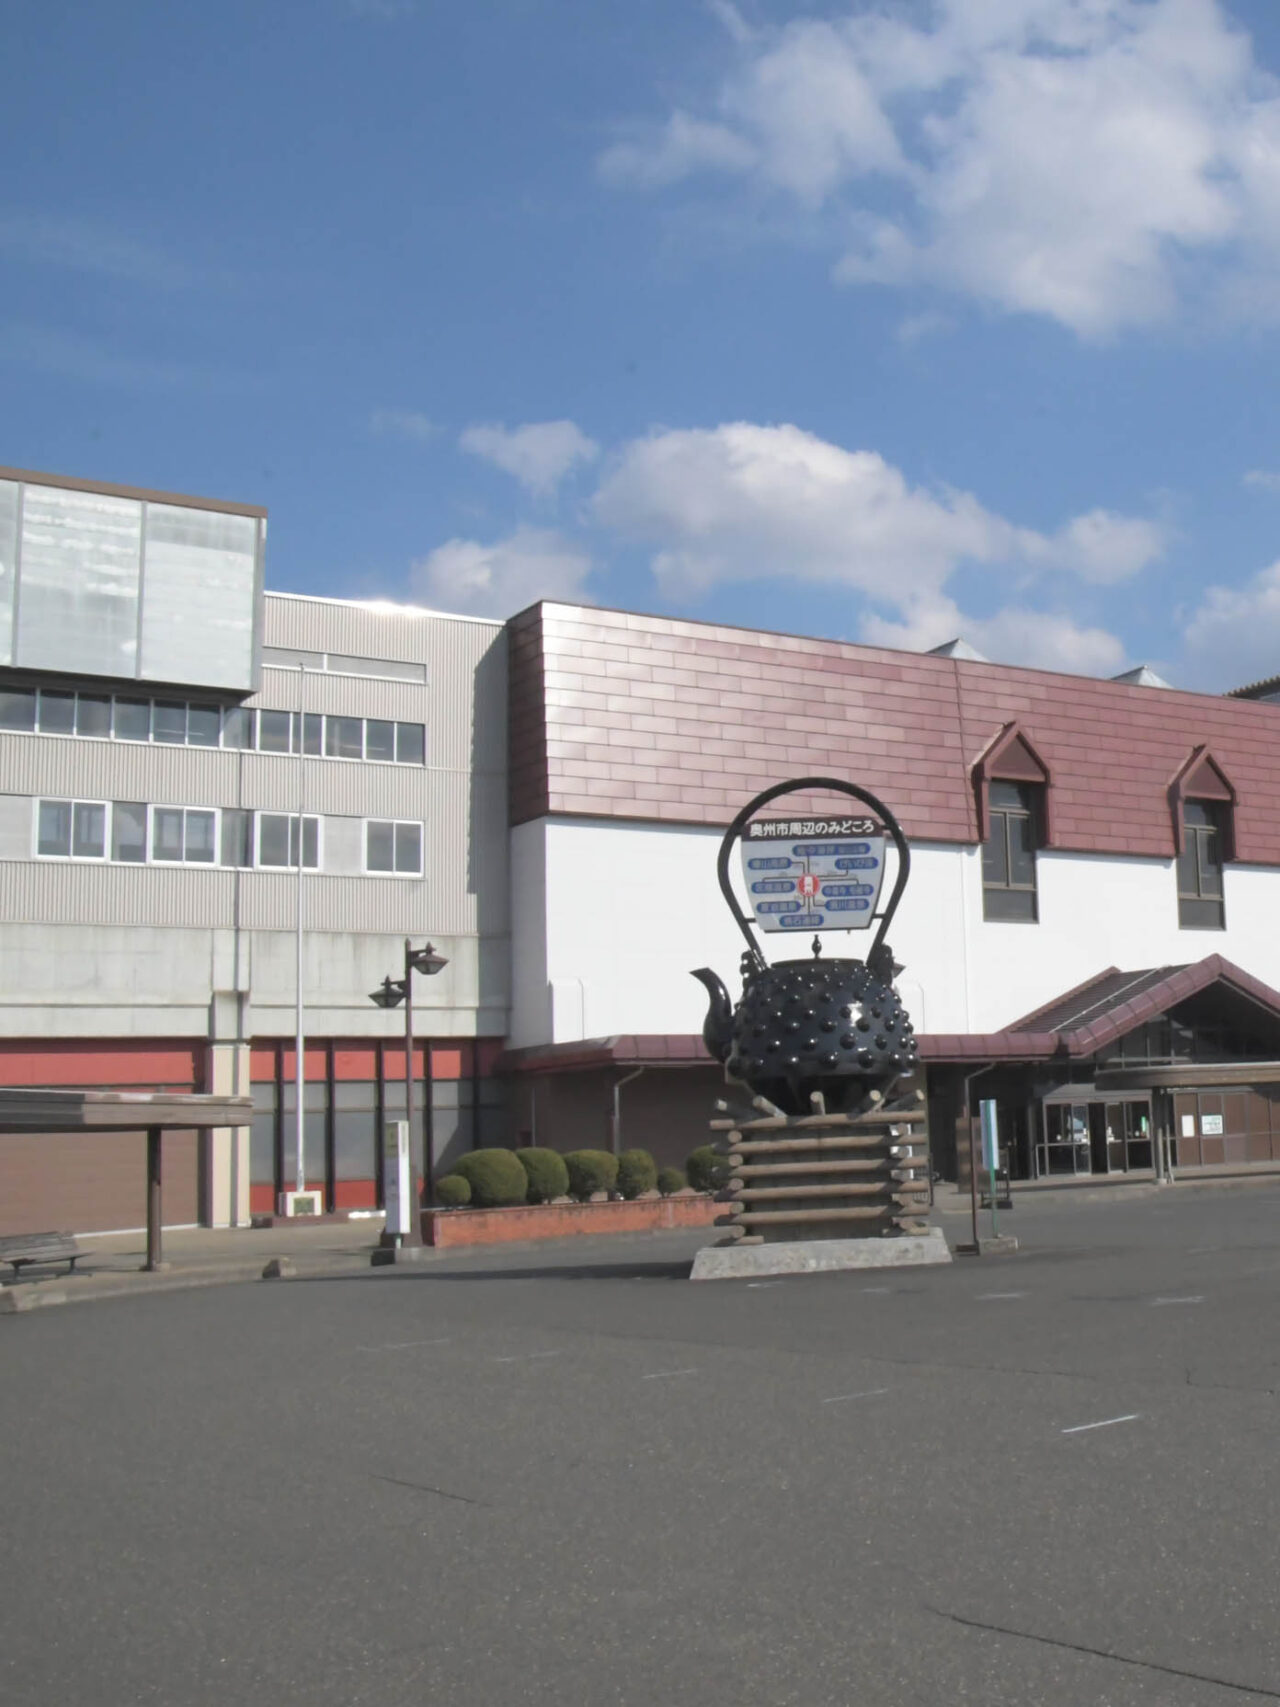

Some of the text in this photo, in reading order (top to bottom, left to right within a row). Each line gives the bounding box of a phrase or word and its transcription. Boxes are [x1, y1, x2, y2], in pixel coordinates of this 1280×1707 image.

[750, 820, 875, 837] 奥州市周辺のみどころ
